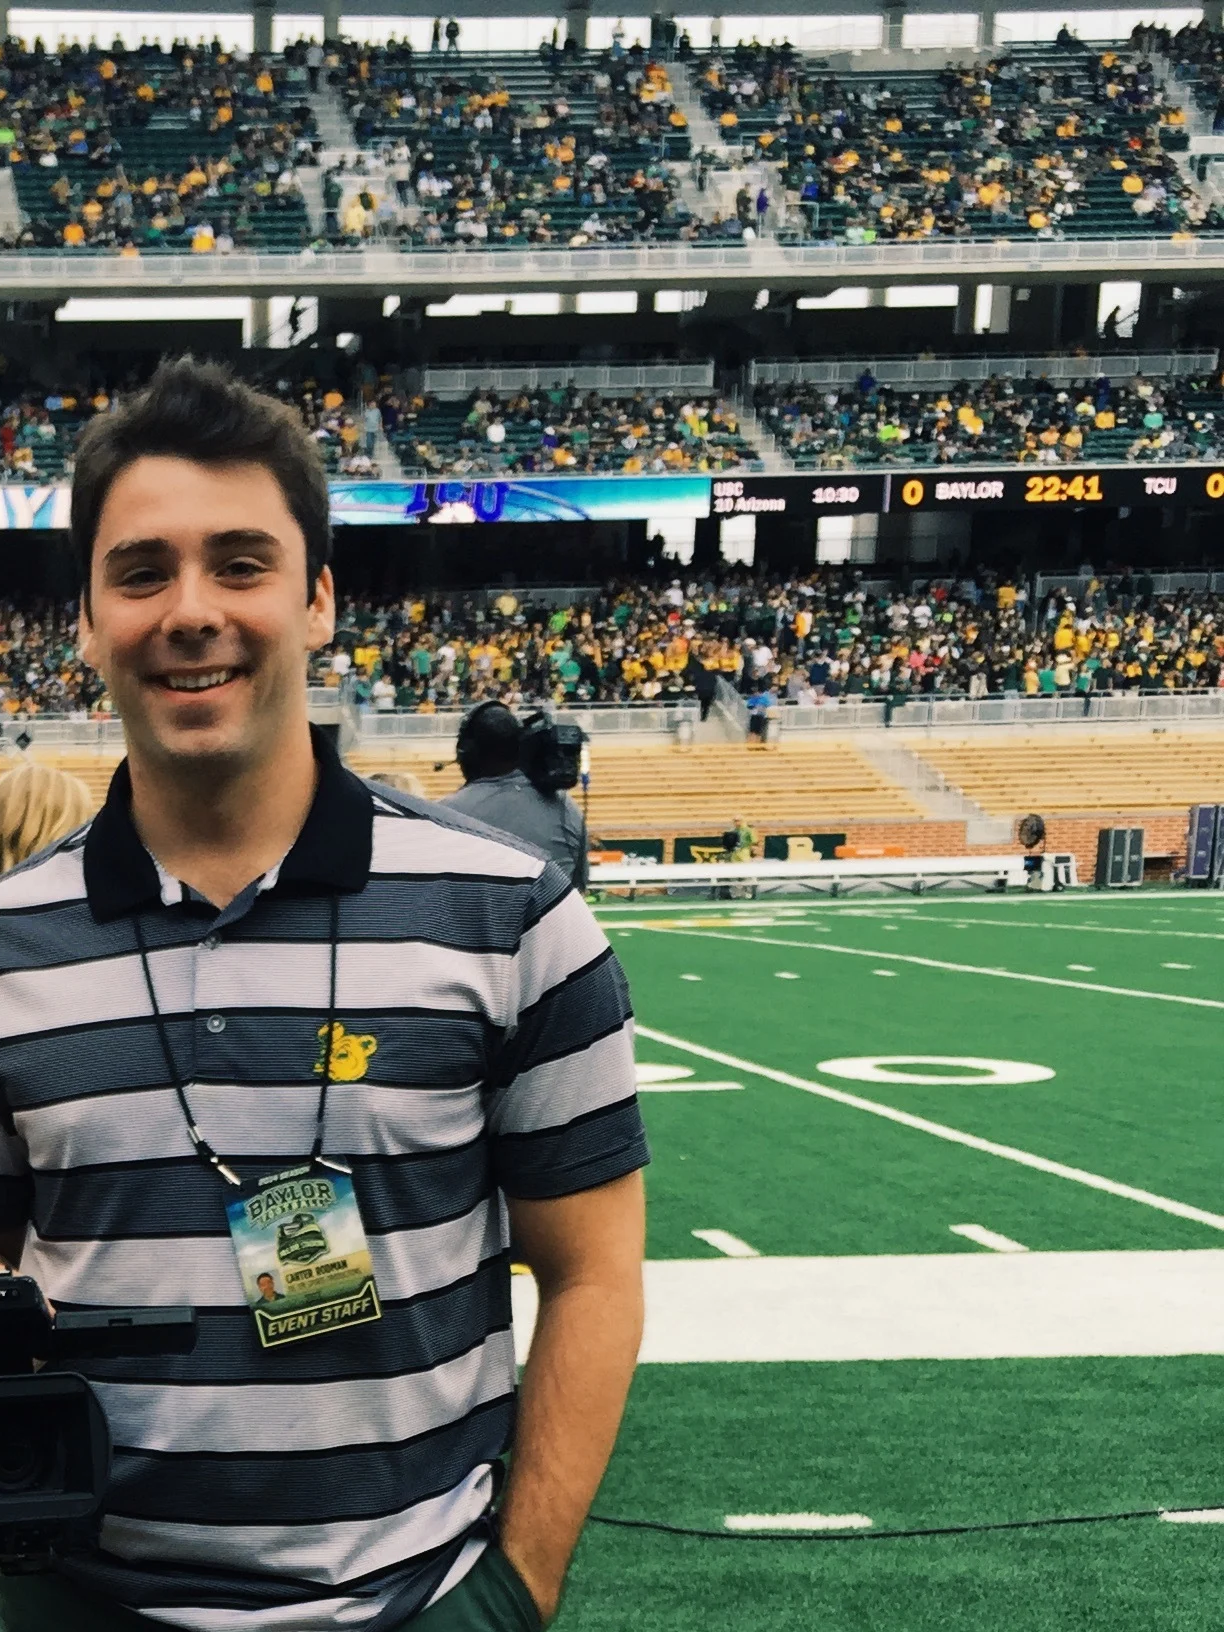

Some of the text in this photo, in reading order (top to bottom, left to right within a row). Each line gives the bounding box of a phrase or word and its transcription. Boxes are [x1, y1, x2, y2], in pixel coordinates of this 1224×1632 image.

[734, 497, 786, 512] Arizona
[902, 480, 924, 506] 0
[935, 481, 1004, 500] BAYLOR
[1025, 475, 1103, 502] 22:41
[1143, 477, 1177, 494] TCU
[248, 1182, 332, 1220] BAYLOR
[267, 1297, 372, 1337] EVENT STAFF
